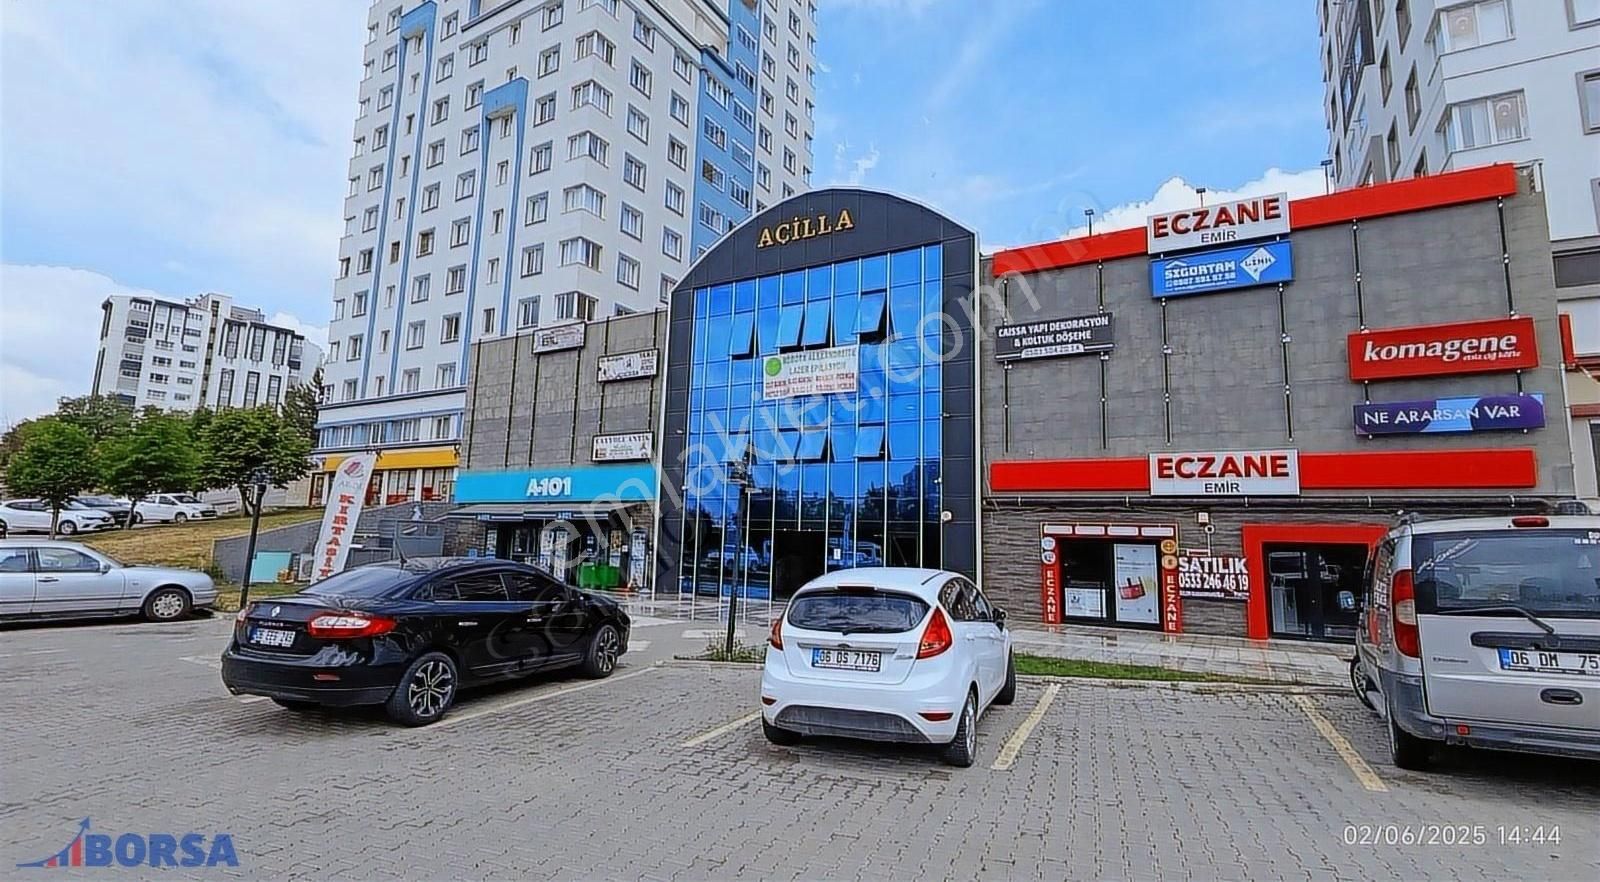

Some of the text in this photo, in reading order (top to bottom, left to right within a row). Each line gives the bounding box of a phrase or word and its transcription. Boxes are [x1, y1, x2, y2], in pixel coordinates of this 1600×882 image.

[1152, 196, 1281, 238] ECZANE
[757, 209, 855, 248] AÇİLLA
[1201, 229, 1237, 243] EMİR
[998, 316, 1109, 338] CAISSA YAPI DEKORASYON
[1022, 334, 1055, 346] KOLTUK
[1364, 334, 1518, 362] komagene
[1364, 404, 1521, 425] NE ARARSAN VAR
[1157, 455, 1290, 479] ECZANE
[1204, 480, 1241, 494] EMİR
[1178, 557, 1249, 574] SATILIK
[1179, 573, 1202, 588] 0533
[1203, 573, 1222, 589] 246
[1238, 574, 1249, 590] 19
[1046, 570, 1057, 622] ECZANE
[1166, 575, 1177, 631] ECZANE
[854, 653, 879, 665] 7176
[1511, 651, 1600, 669] 06 DM 75
